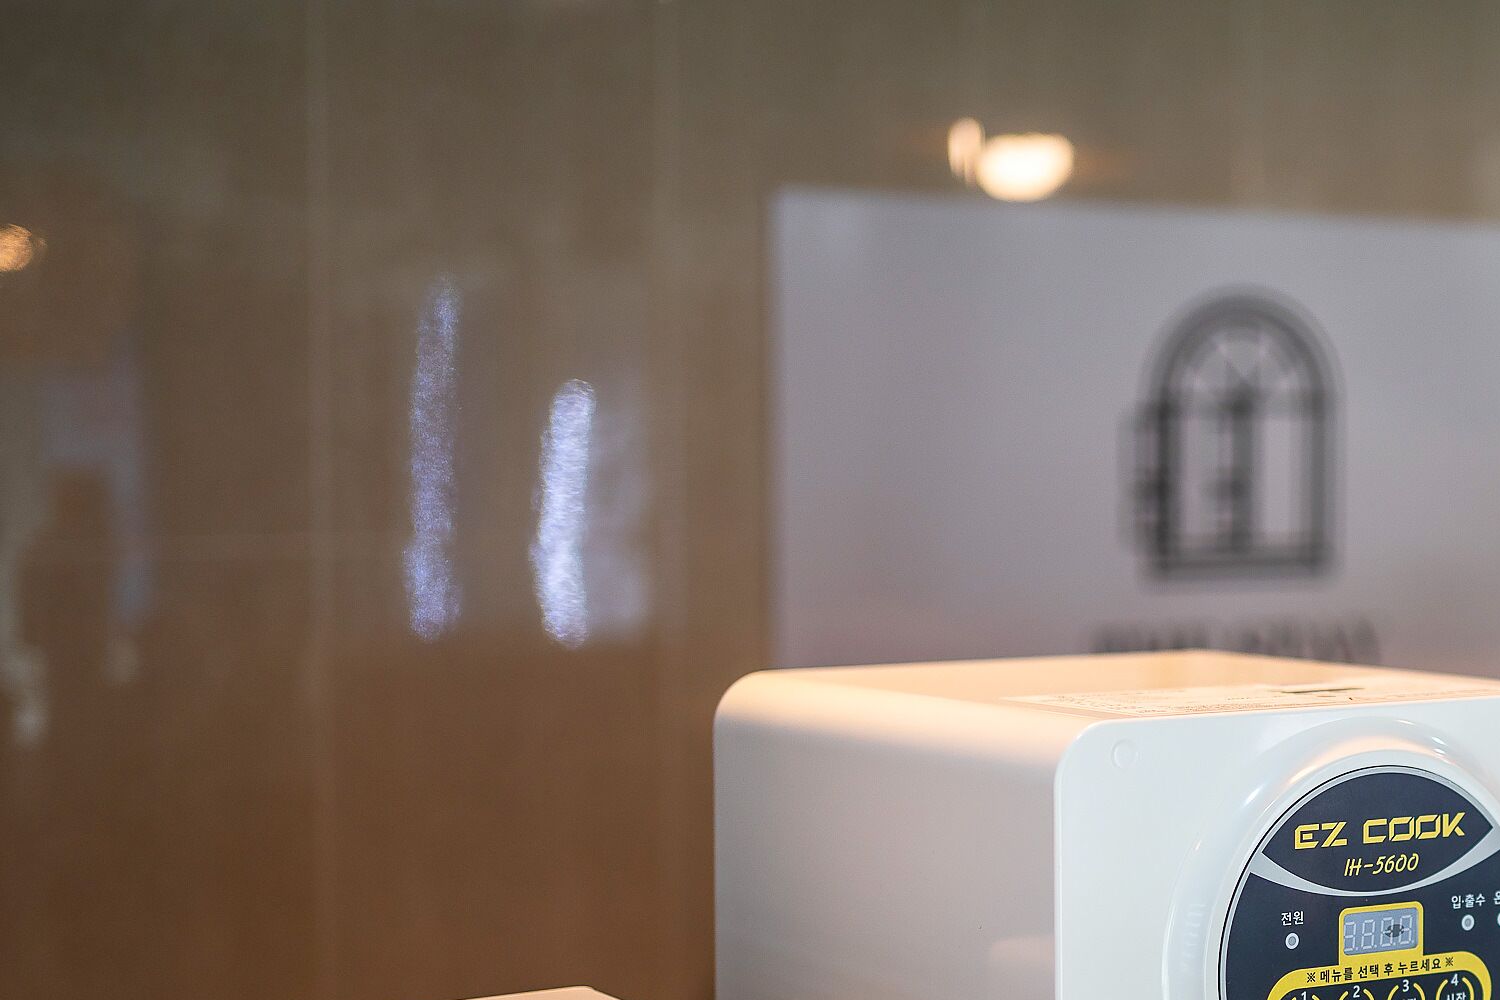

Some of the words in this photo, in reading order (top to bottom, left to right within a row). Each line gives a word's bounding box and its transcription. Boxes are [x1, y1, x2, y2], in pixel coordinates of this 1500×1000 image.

[1294, 821, 1348, 849] EZ
[1362, 812, 1466, 844] COOK
[1344, 853, 1419, 877] IH-5600
[1281, 911, 1304, 926] 전원
[1320, 967, 1353, 983] 메뉴를
[1358, 963, 1379, 978] 선택
[1383, 962, 1394, 974] 후
[1398, 958, 1441, 972] 누르세요
[1402, 980, 1410, 992] 3
[1451, 974, 1459, 986] 4
[1353, 986, 1360, 998] 2
